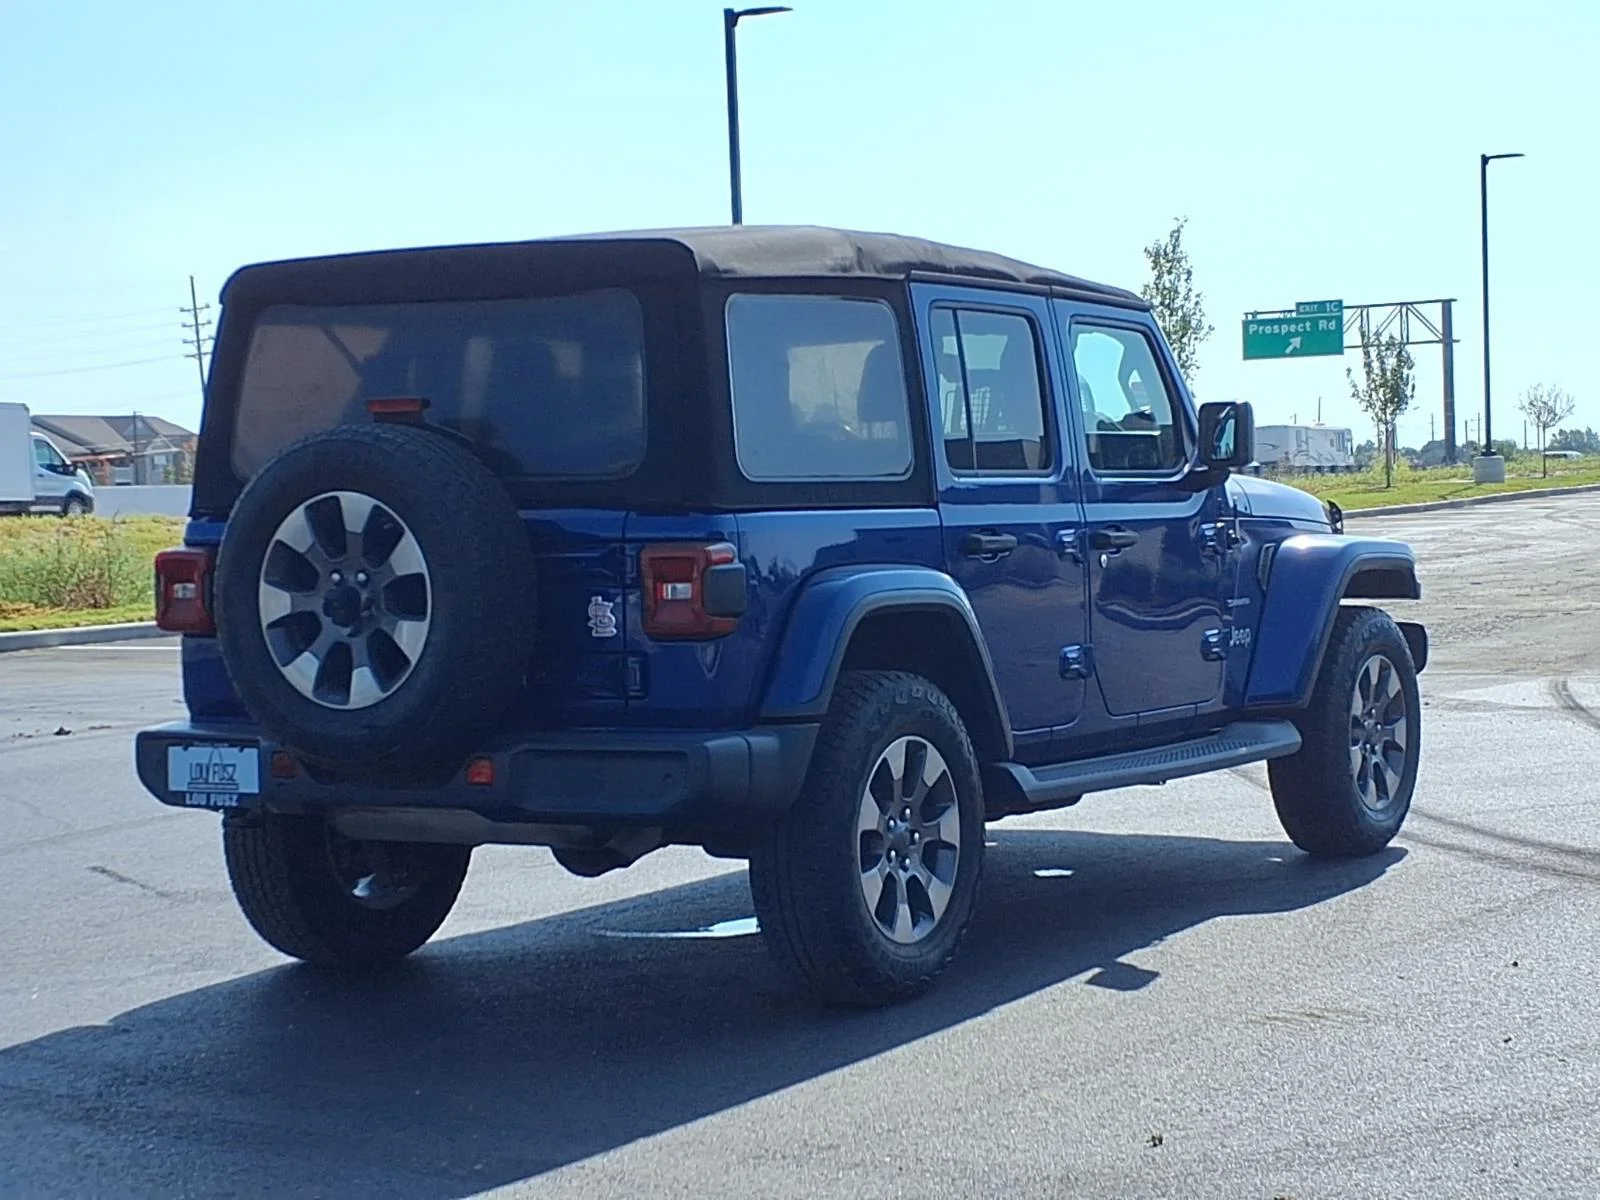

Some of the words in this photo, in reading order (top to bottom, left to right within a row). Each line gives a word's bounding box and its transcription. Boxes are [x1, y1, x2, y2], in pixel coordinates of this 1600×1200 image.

[1299, 303, 1319, 313] EXIT
[1325, 301, 1340, 312] 1C
[1248, 320, 1312, 336] Prospect
[1318, 319, 1337, 331] Rd
[1229, 625, 1251, 648] Jeep
[189, 762, 209, 783] LOU
[185, 792, 207, 805] LOU
[209, 793, 239, 806] FUSZ
